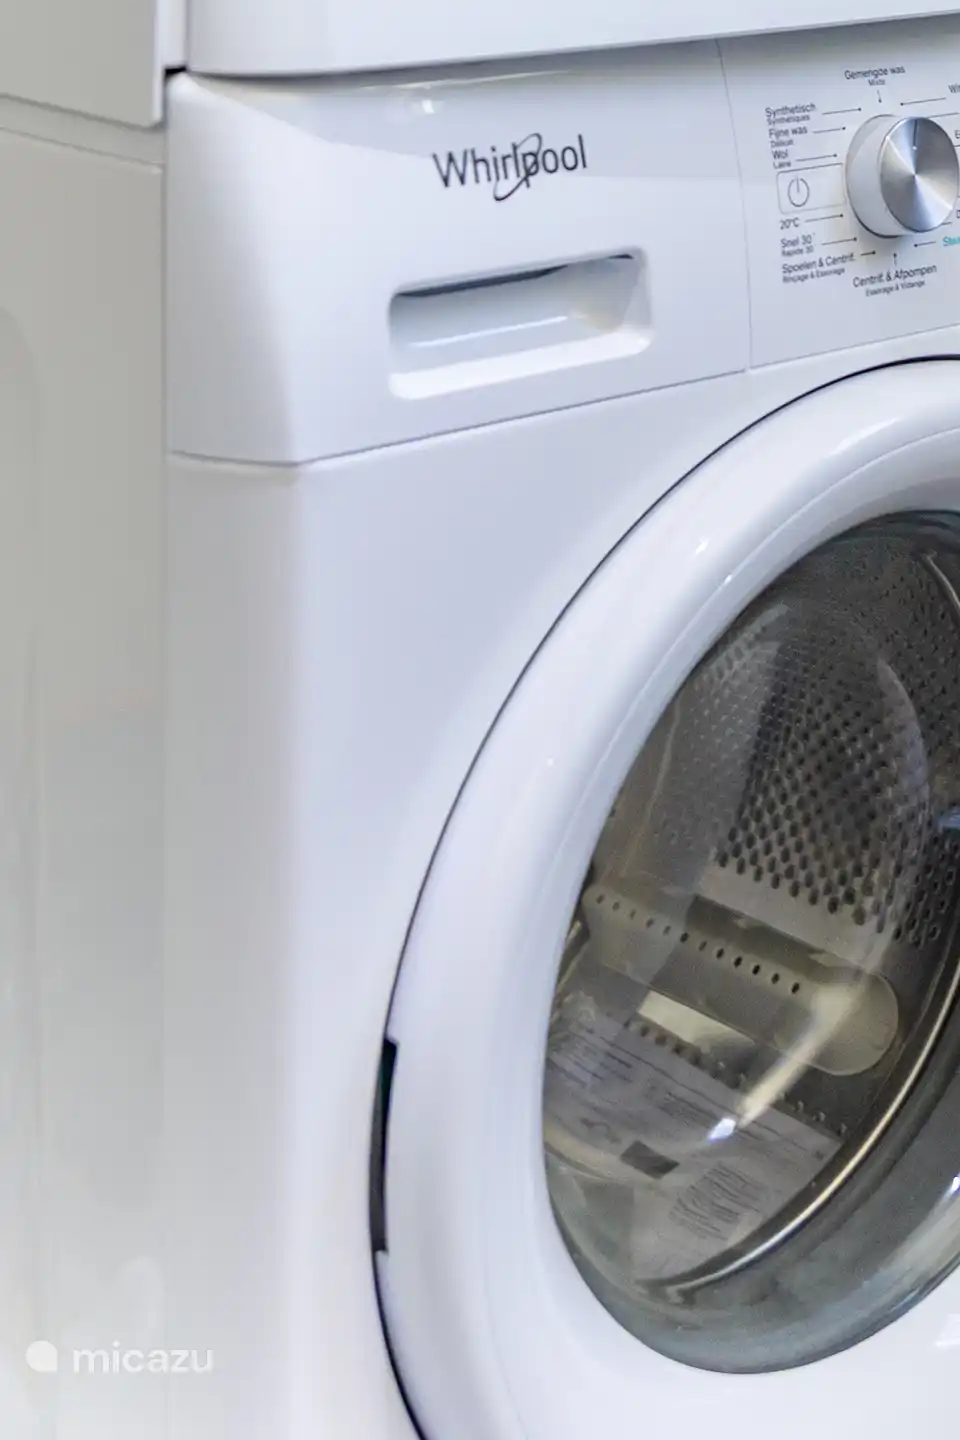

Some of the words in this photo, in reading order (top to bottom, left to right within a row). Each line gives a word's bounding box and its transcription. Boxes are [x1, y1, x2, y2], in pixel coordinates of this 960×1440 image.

[844, 68, 888, 80] Gemengde
[764, 103, 818, 118] Synthetisch
[431, 132, 588, 202] Whirlpool
[782, 261, 817, 274] Spoelen
[893, 265, 938, 281] Afpompen
